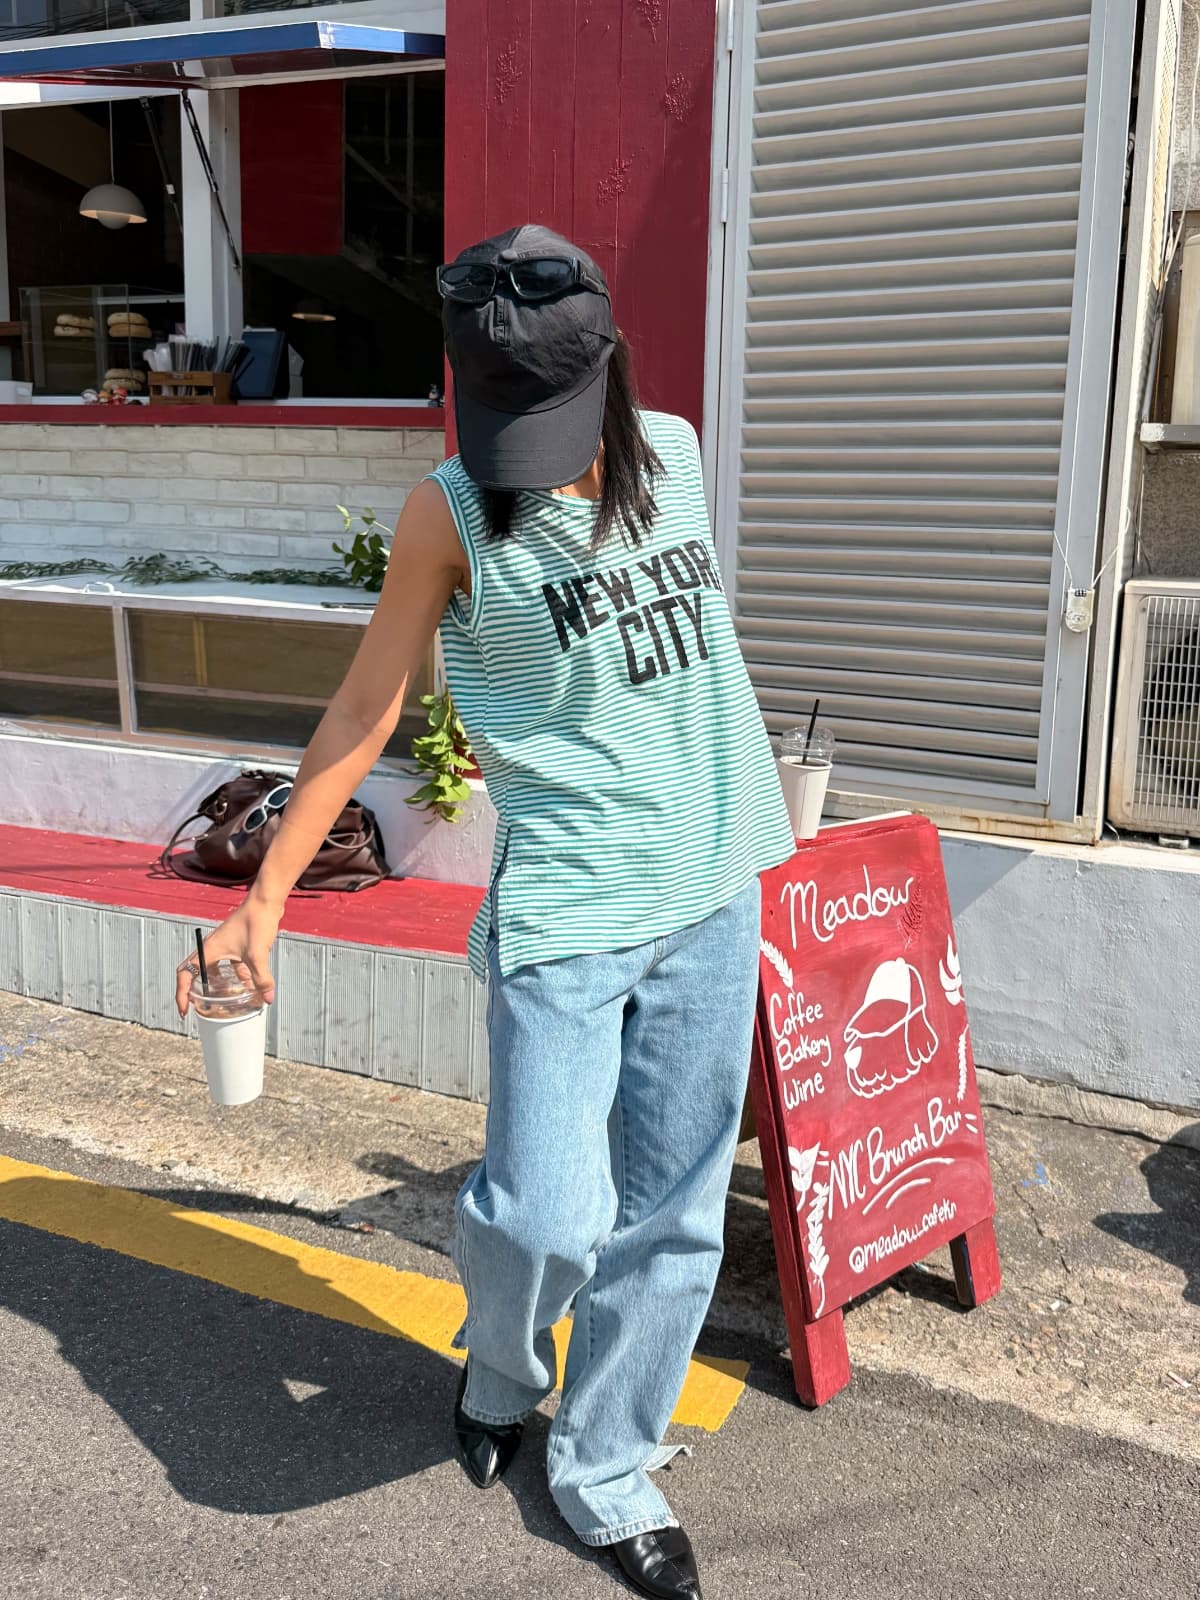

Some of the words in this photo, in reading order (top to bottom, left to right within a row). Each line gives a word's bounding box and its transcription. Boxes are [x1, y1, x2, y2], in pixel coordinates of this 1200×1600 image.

[541, 567, 637, 653] NEW
[637, 539, 723, 596] YOR
[617, 592, 709, 685] CITY
[780, 864, 915, 950] Meadow
[769, 991, 824, 1041] Coffee
[775, 1033, 832, 1072] Bakery
[783, 1072, 825, 1111] Wine
[827, 1138, 867, 1220] NYC
[866, 1126, 929, 1186] Brunch
[927, 1096, 962, 1148] Bar
